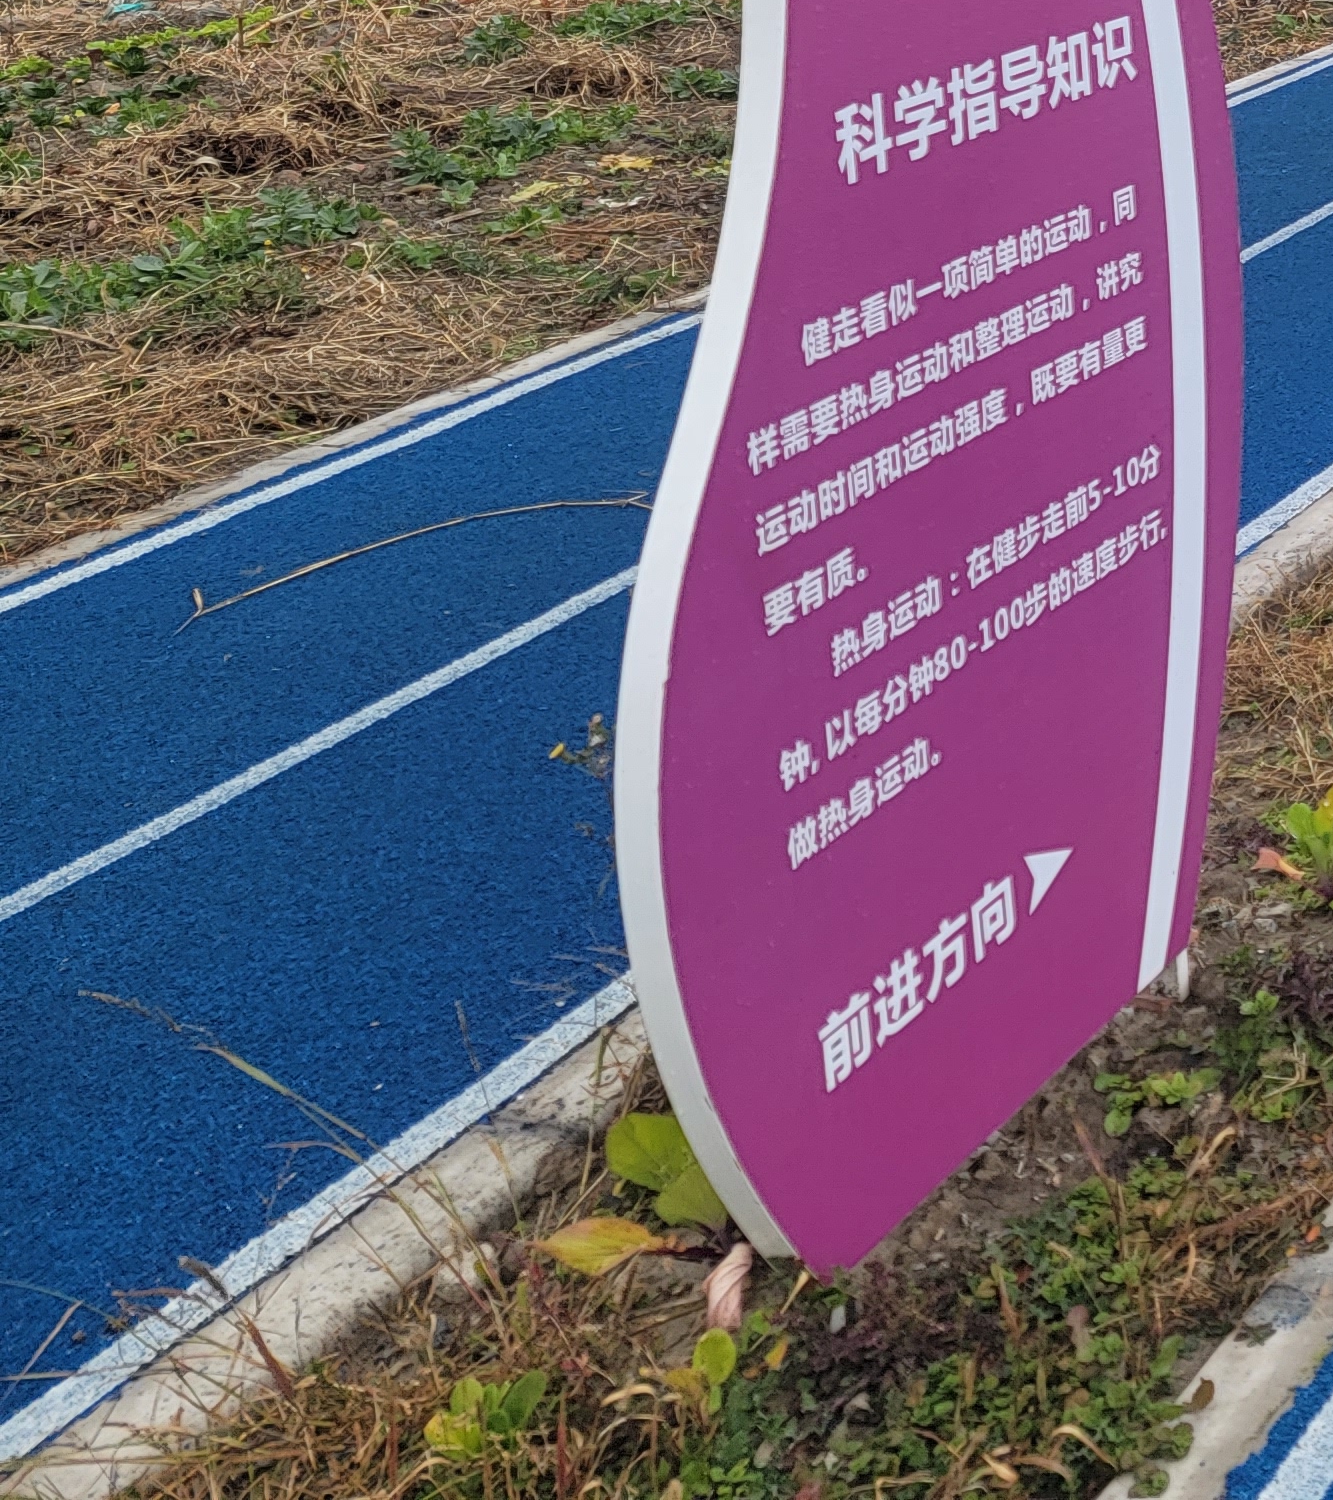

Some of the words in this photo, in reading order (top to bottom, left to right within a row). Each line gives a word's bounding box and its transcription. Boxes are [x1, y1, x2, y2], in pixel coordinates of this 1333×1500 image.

[835, 15, 1138, 185] 科学指导知识
[762, 547, 868, 638] 要有质。
[787, 738, 942, 870] 做热身运动。
[817, 876, 1017, 1093] 前进方向
